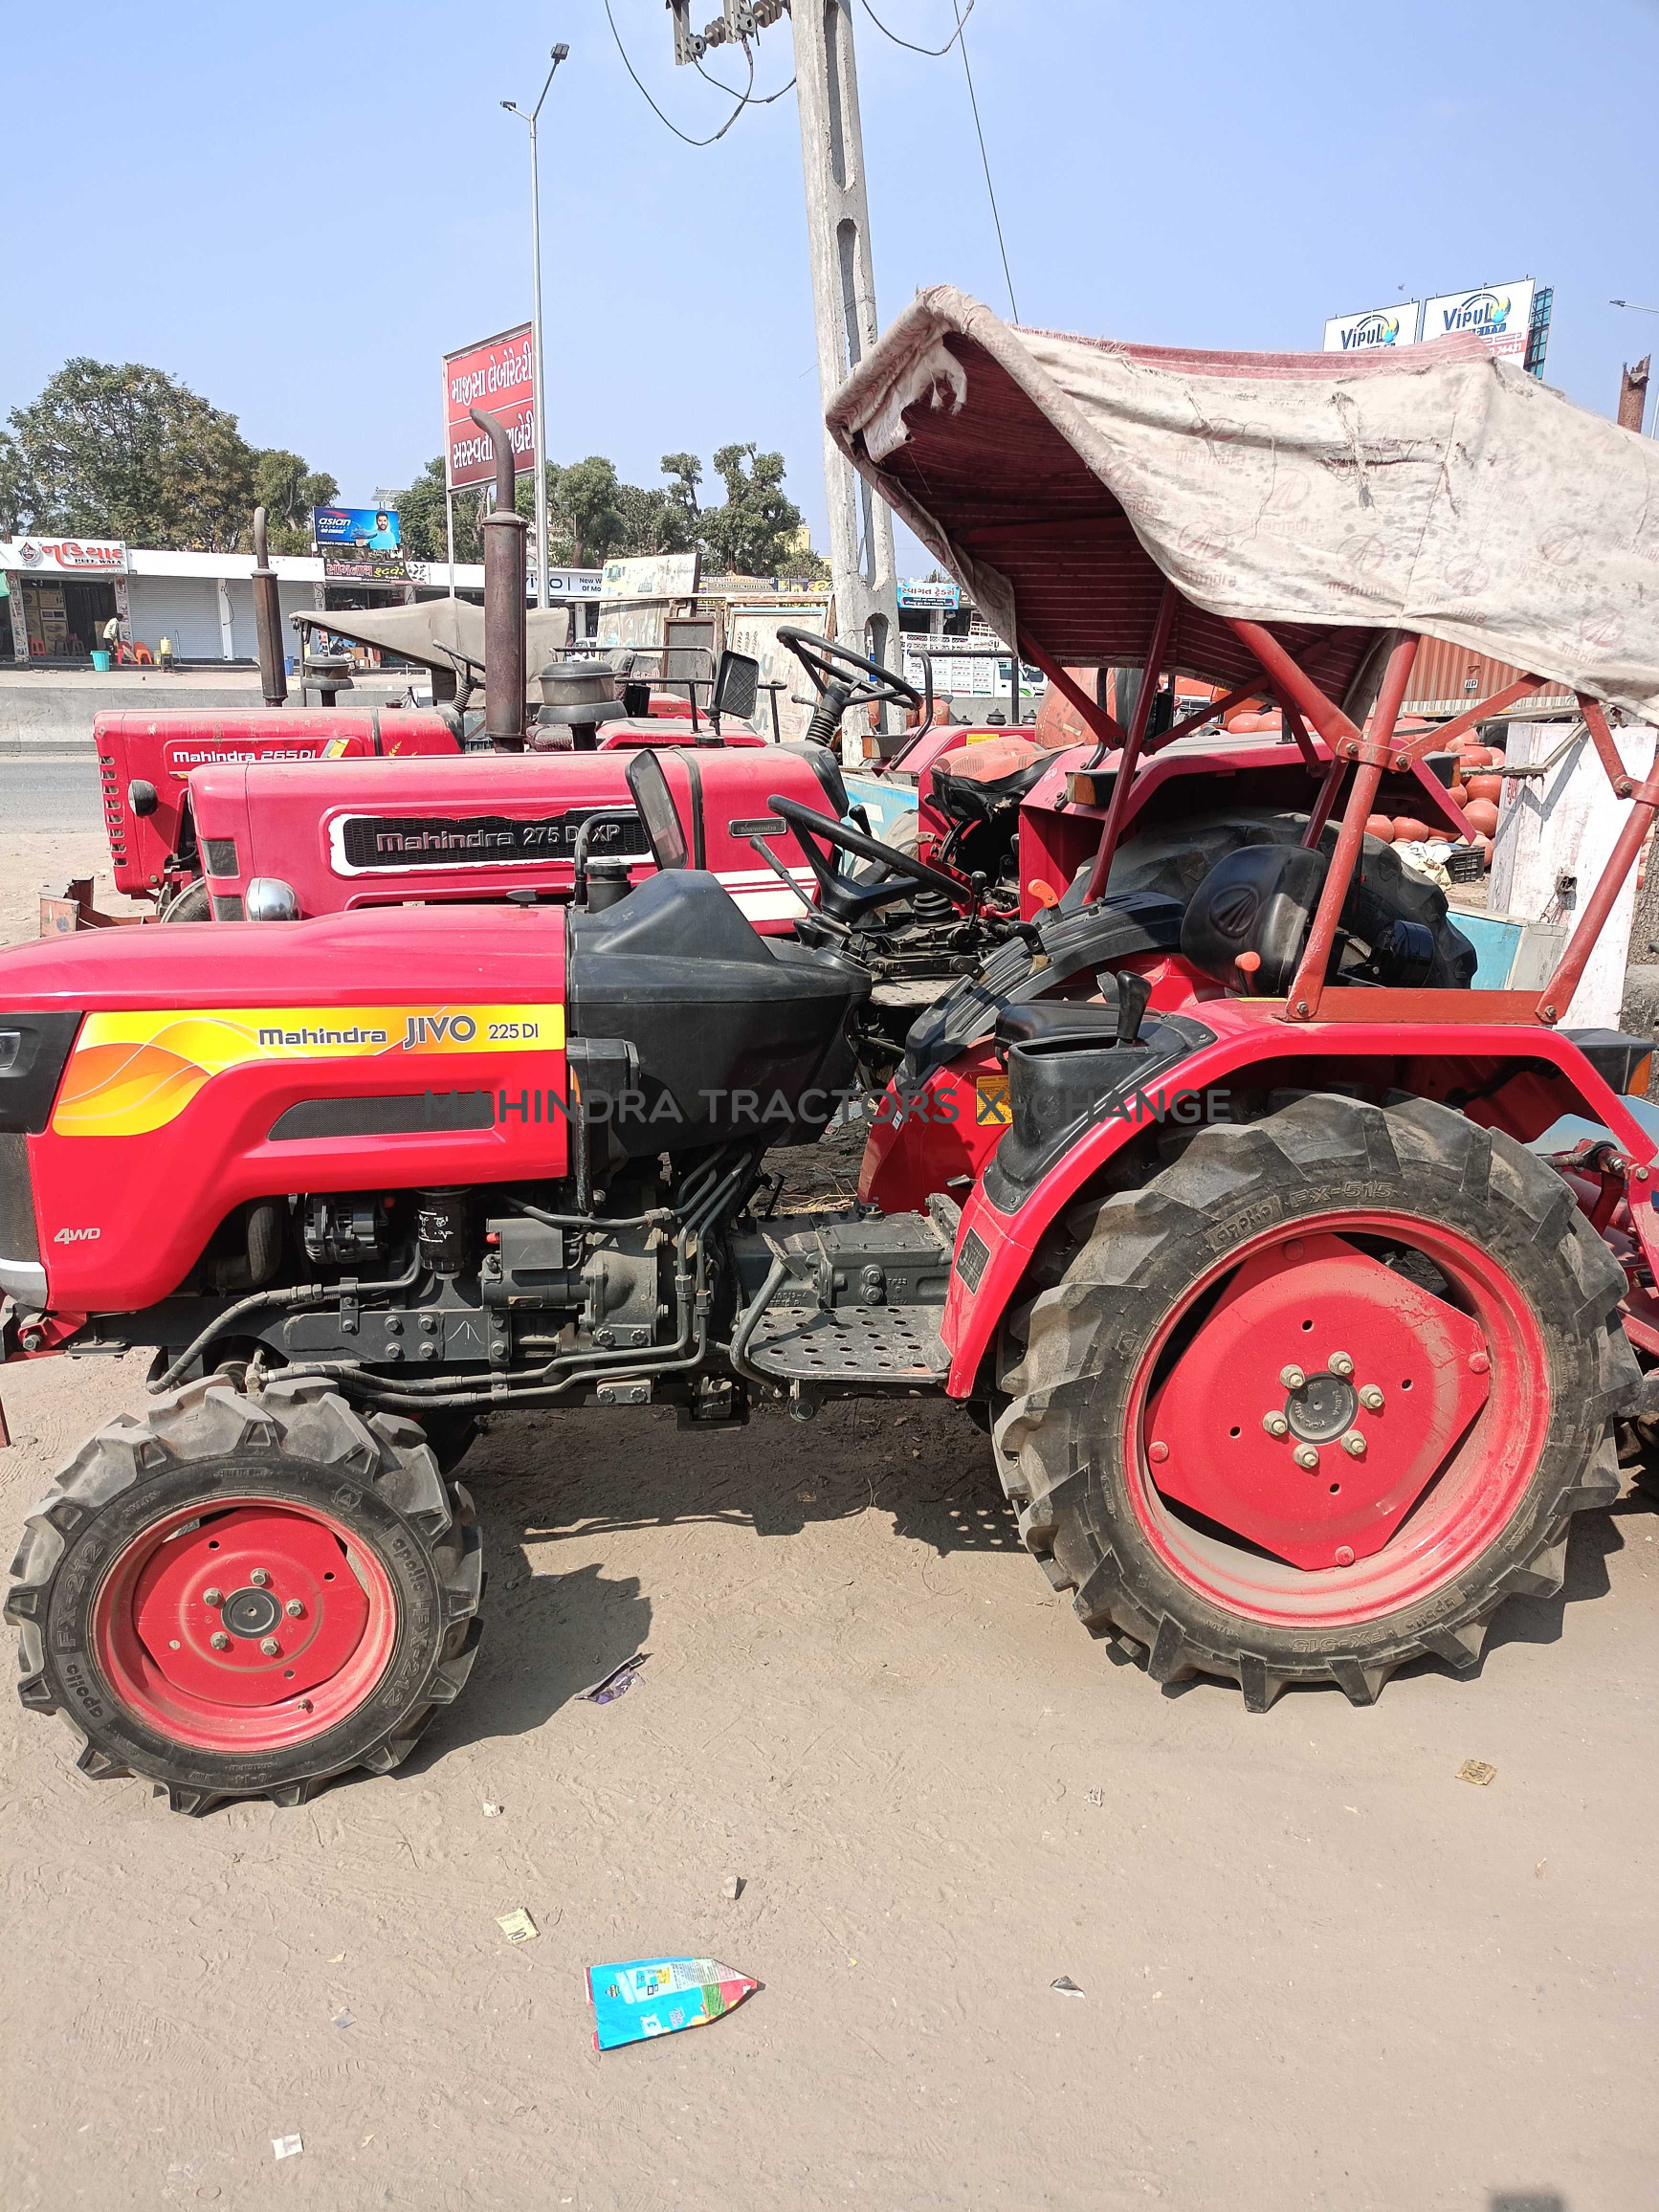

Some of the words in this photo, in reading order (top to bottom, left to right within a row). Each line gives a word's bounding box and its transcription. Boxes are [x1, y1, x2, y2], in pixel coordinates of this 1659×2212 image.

[319, 518, 351, 526] asian
[173, 750, 256, 763] Mahindra
[376, 828, 517, 852] Mahindra
[522, 827, 560, 846] 275
[591, 824, 621, 843] XP
[259, 1027, 387, 1046] Mahindra
[402, 1014, 477, 1051] JIVO
[1290, 1181, 1393, 1208] FX-515
[54, 1227, 101, 1245] 4WD
[57, 1540, 105, 1648] FX-212
[1292, 1626, 1387, 1653] FX-515
[383, 1608, 431, 1710] FX-212
[66, 1664, 104, 1719] apollo
